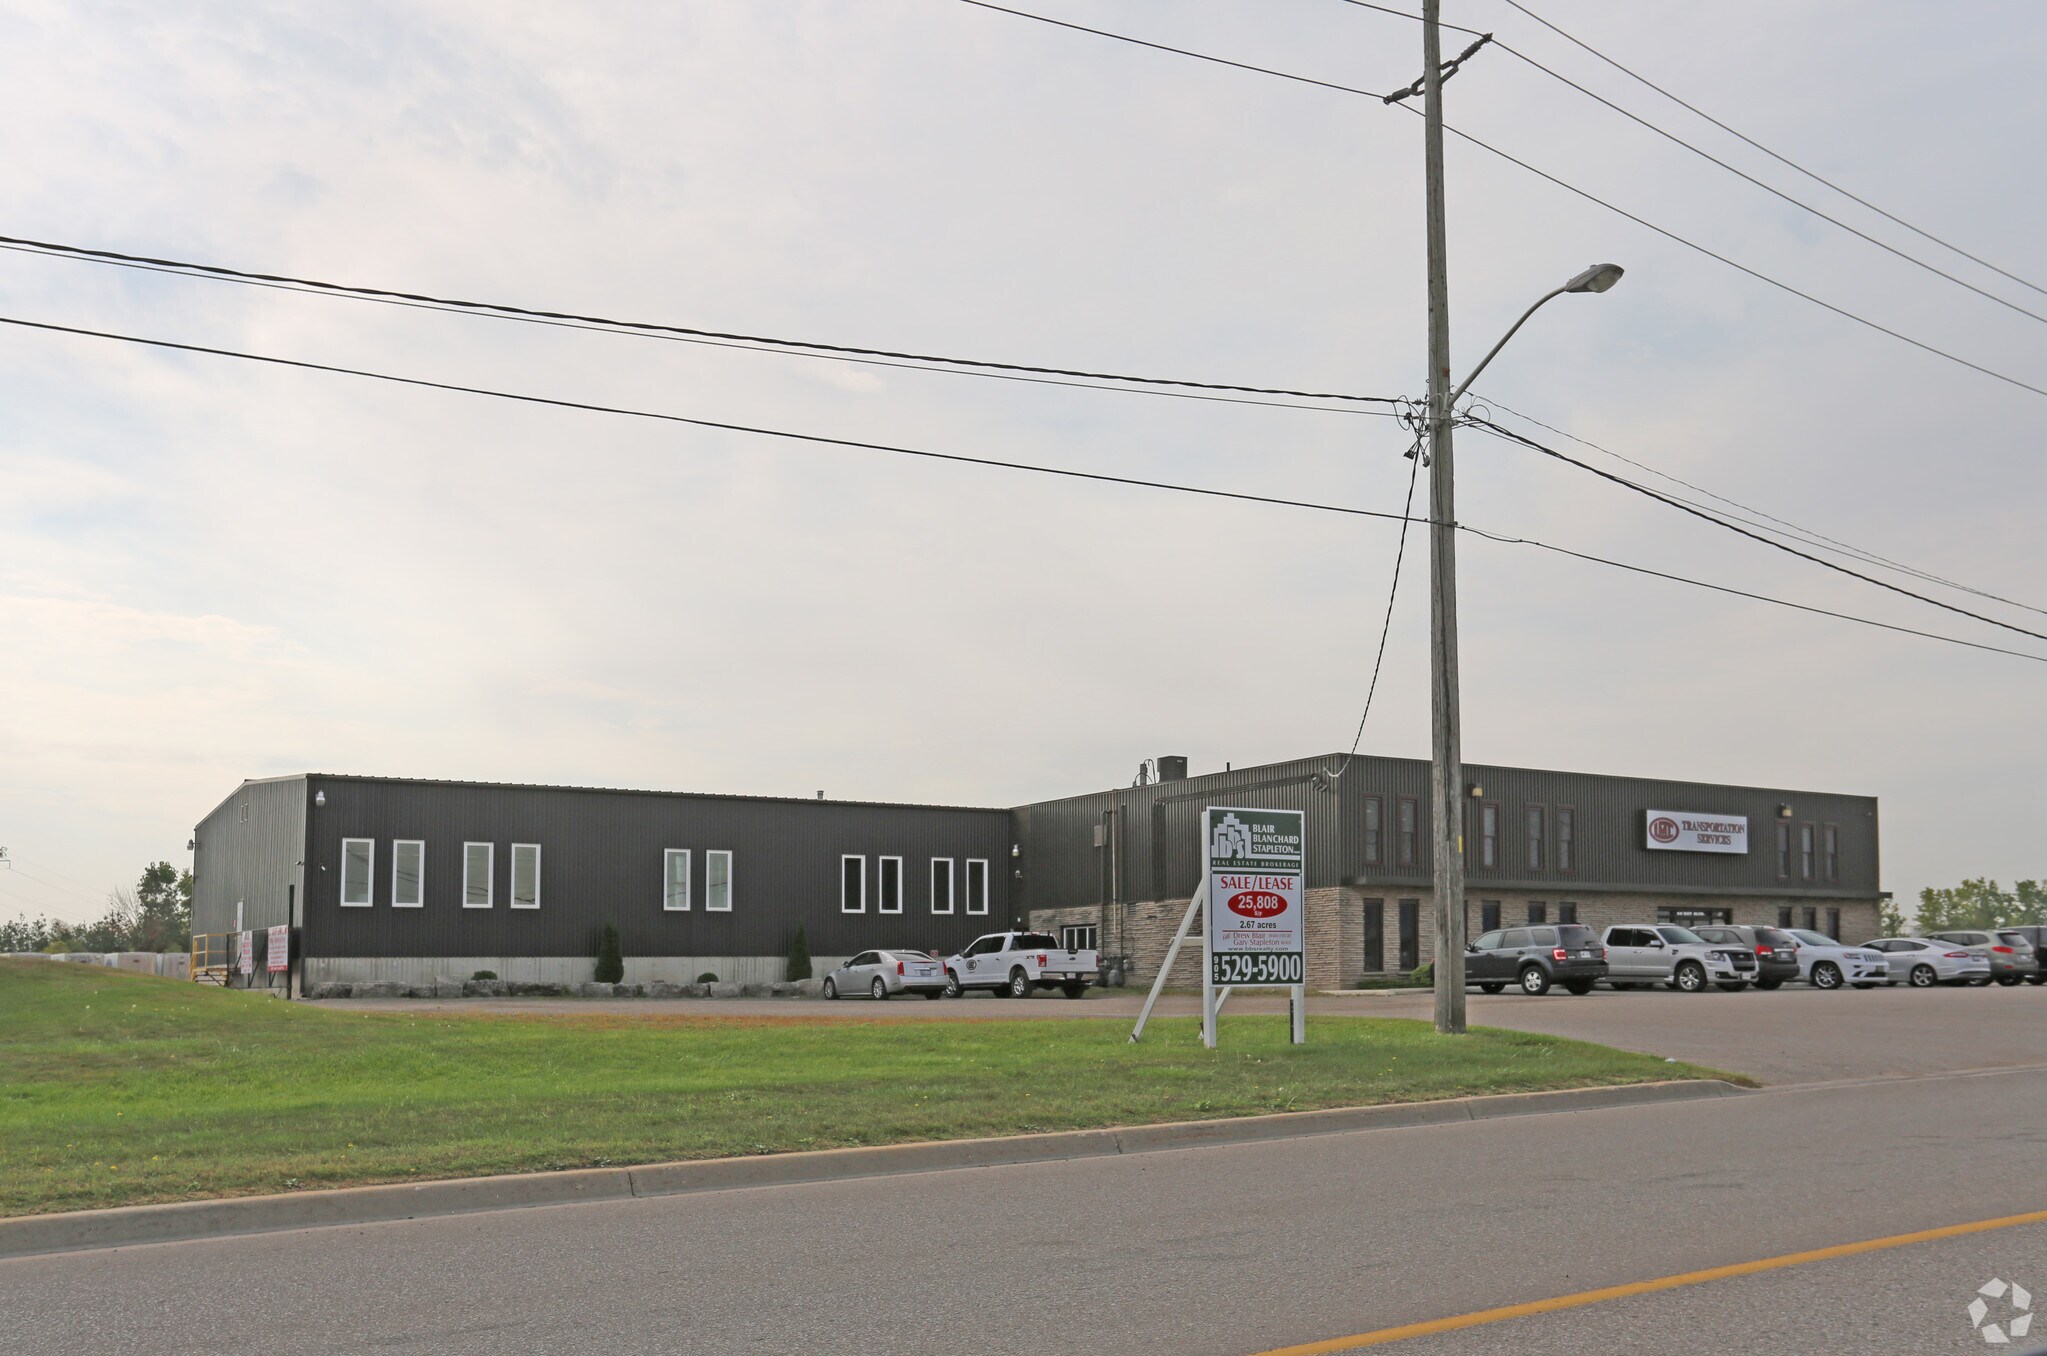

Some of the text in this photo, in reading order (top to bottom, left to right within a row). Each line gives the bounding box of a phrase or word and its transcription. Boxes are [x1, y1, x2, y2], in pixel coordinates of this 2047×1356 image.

[1252, 824, 1274, 833] BLAIR
[1682, 820, 1745, 834] TRANSPORTATION
[1252, 834, 1299, 844] BLANCHARD
[1697, 834, 1731, 845] SERVICES
[1253, 844, 1294, 854] STAPLETON
[1220, 875, 1293, 890] SALE/LEASE
[1238, 895, 1278, 911] 25,808
[1221, 955, 1301, 982] 529-5900
